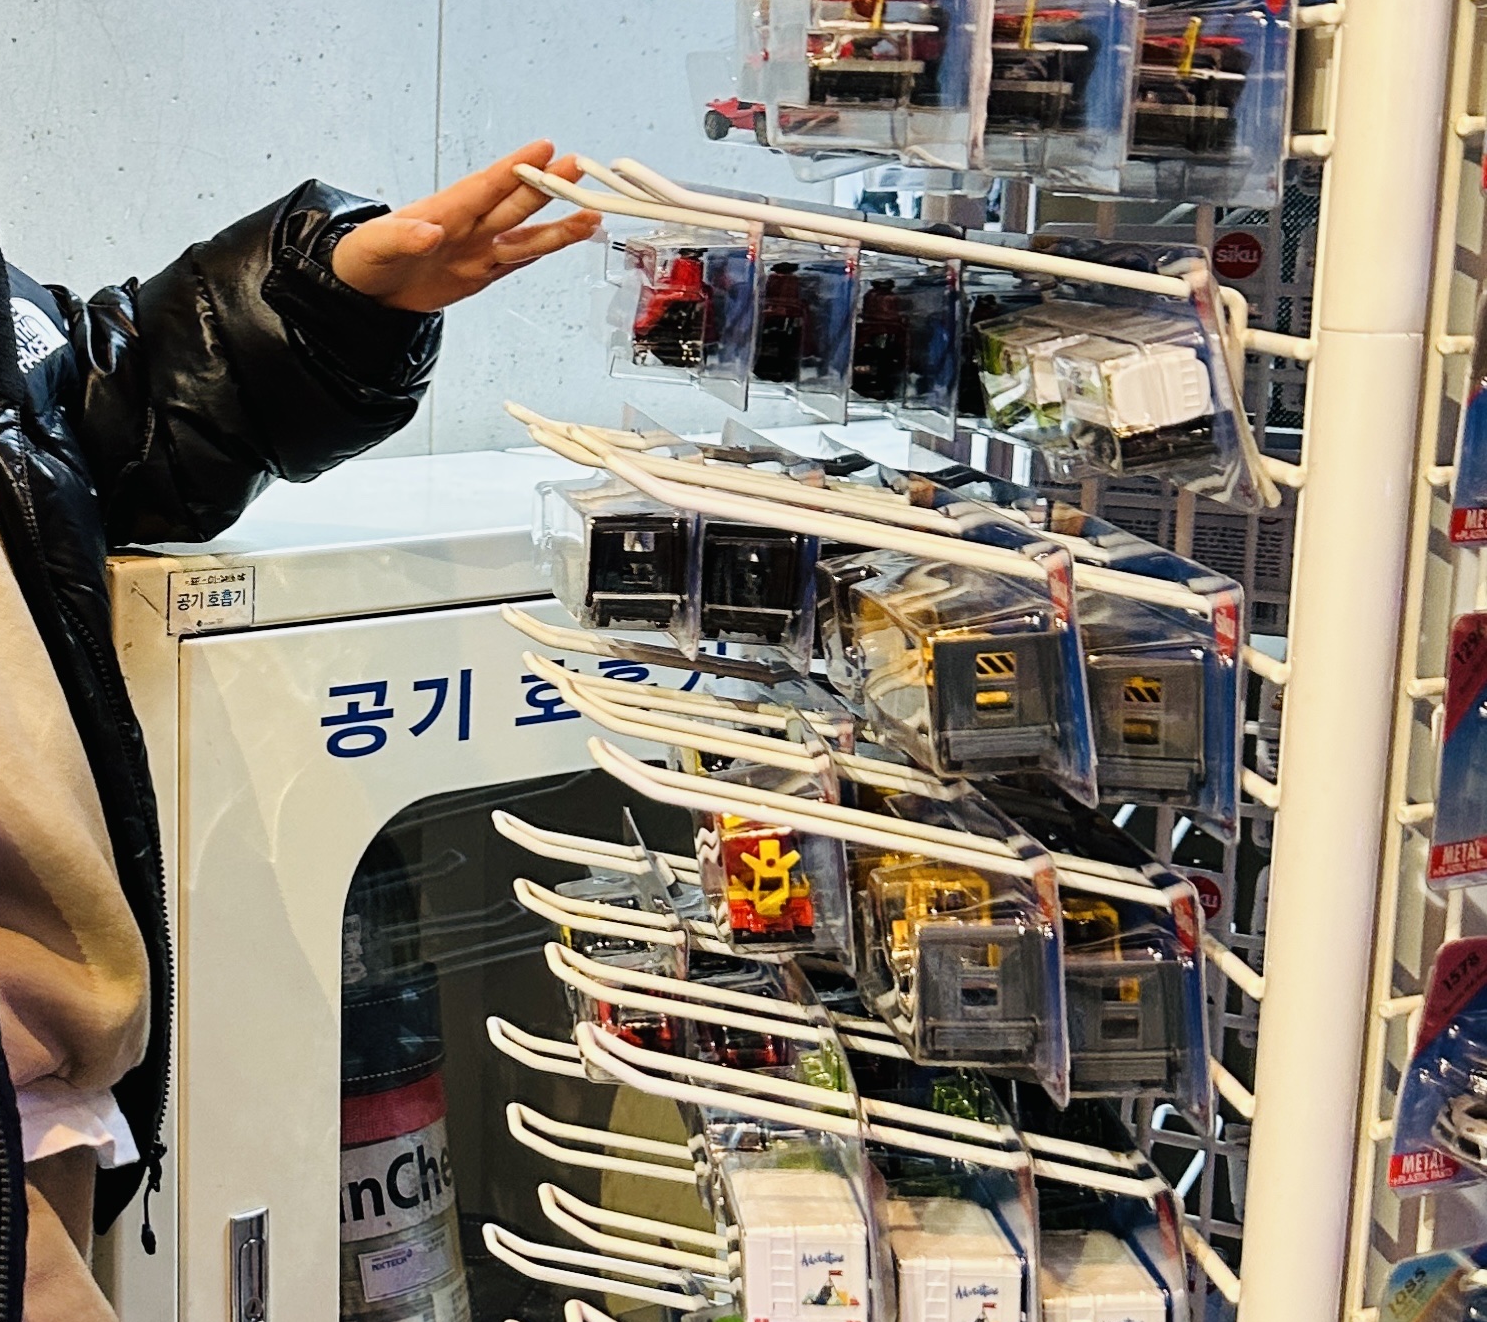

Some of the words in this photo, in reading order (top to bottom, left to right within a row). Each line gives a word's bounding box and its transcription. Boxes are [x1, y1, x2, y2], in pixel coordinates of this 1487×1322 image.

[1216, 247, 1259, 263] siku
[177, 592, 203, 611] 공기
[207, 588, 246, 608] 호흡기
[320, 669, 472, 759] 공기
[1442, 840, 1484, 865] METAL
[1443, 952, 1480, 991] 1578
[1402, 1151, 1445, 1174] METAL
